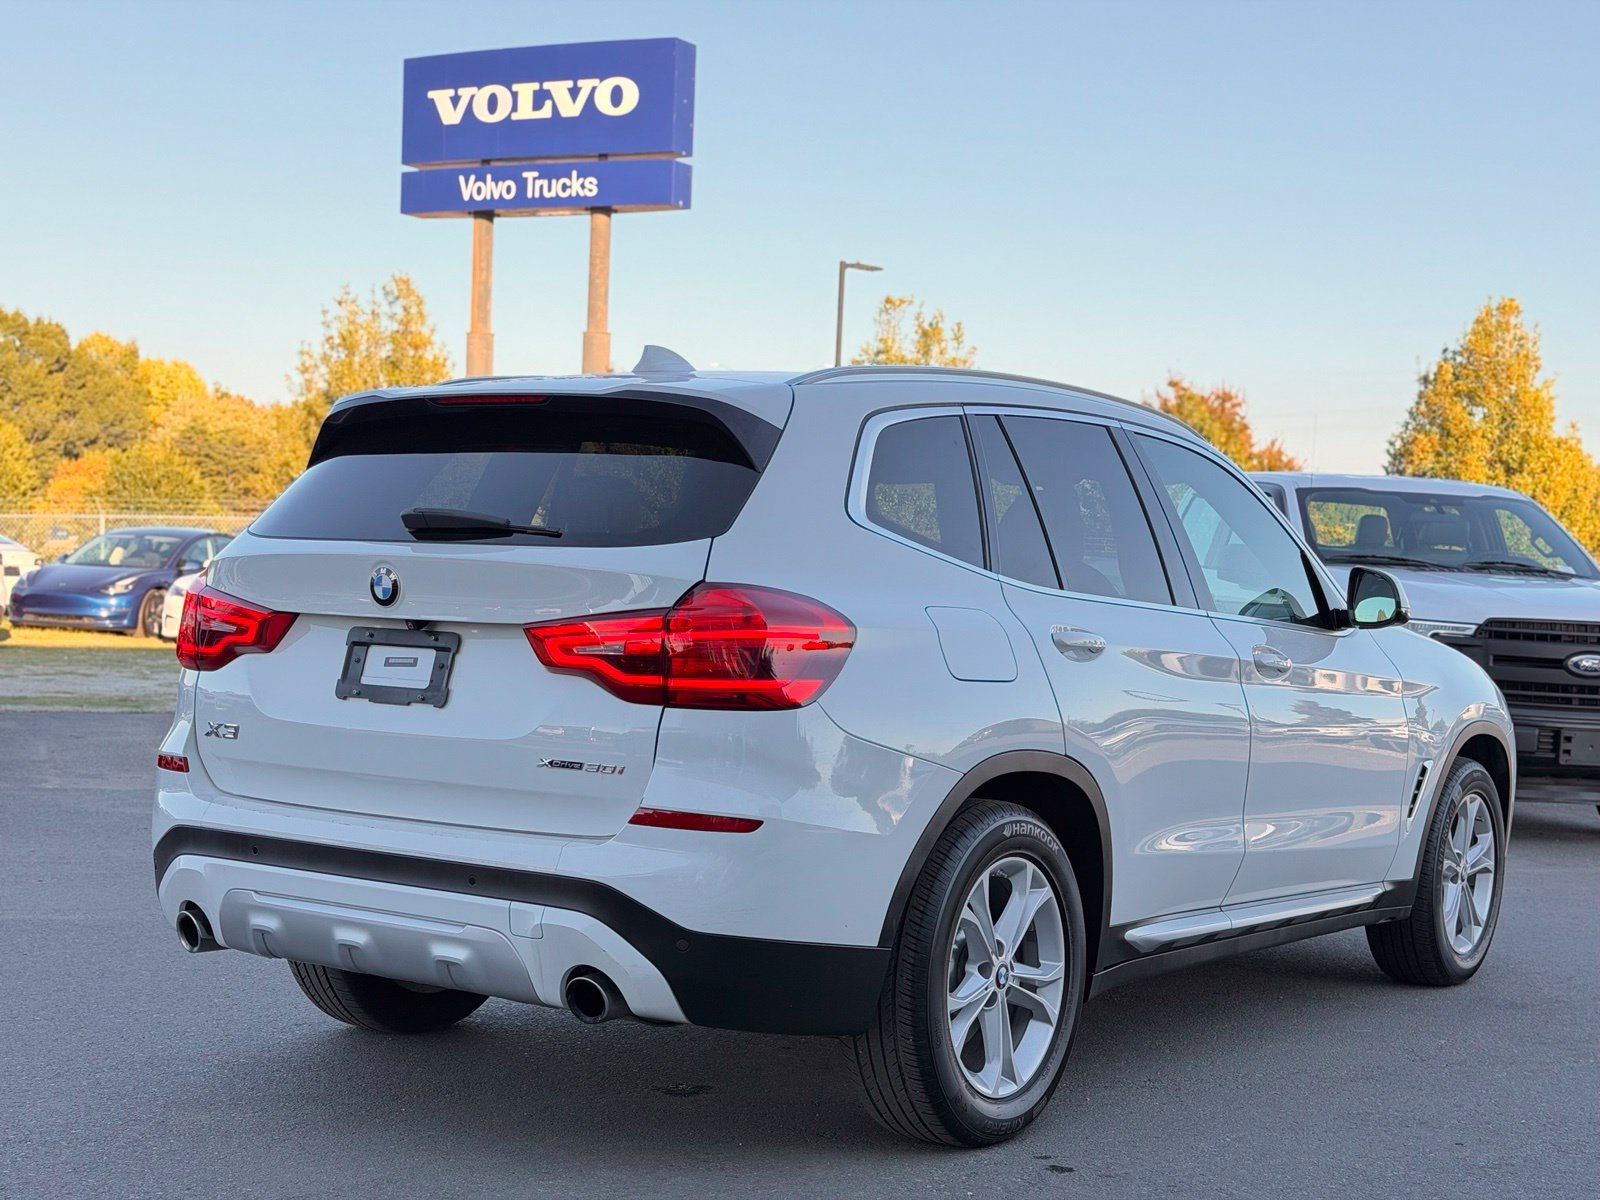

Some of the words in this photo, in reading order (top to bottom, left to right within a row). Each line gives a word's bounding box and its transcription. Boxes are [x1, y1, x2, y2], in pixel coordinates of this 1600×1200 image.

[427, 76, 640, 126] VOLVO
[458, 173, 517, 202] Volvo
[522, 170, 599, 198] Trucks
[204, 721, 240, 740] X3
